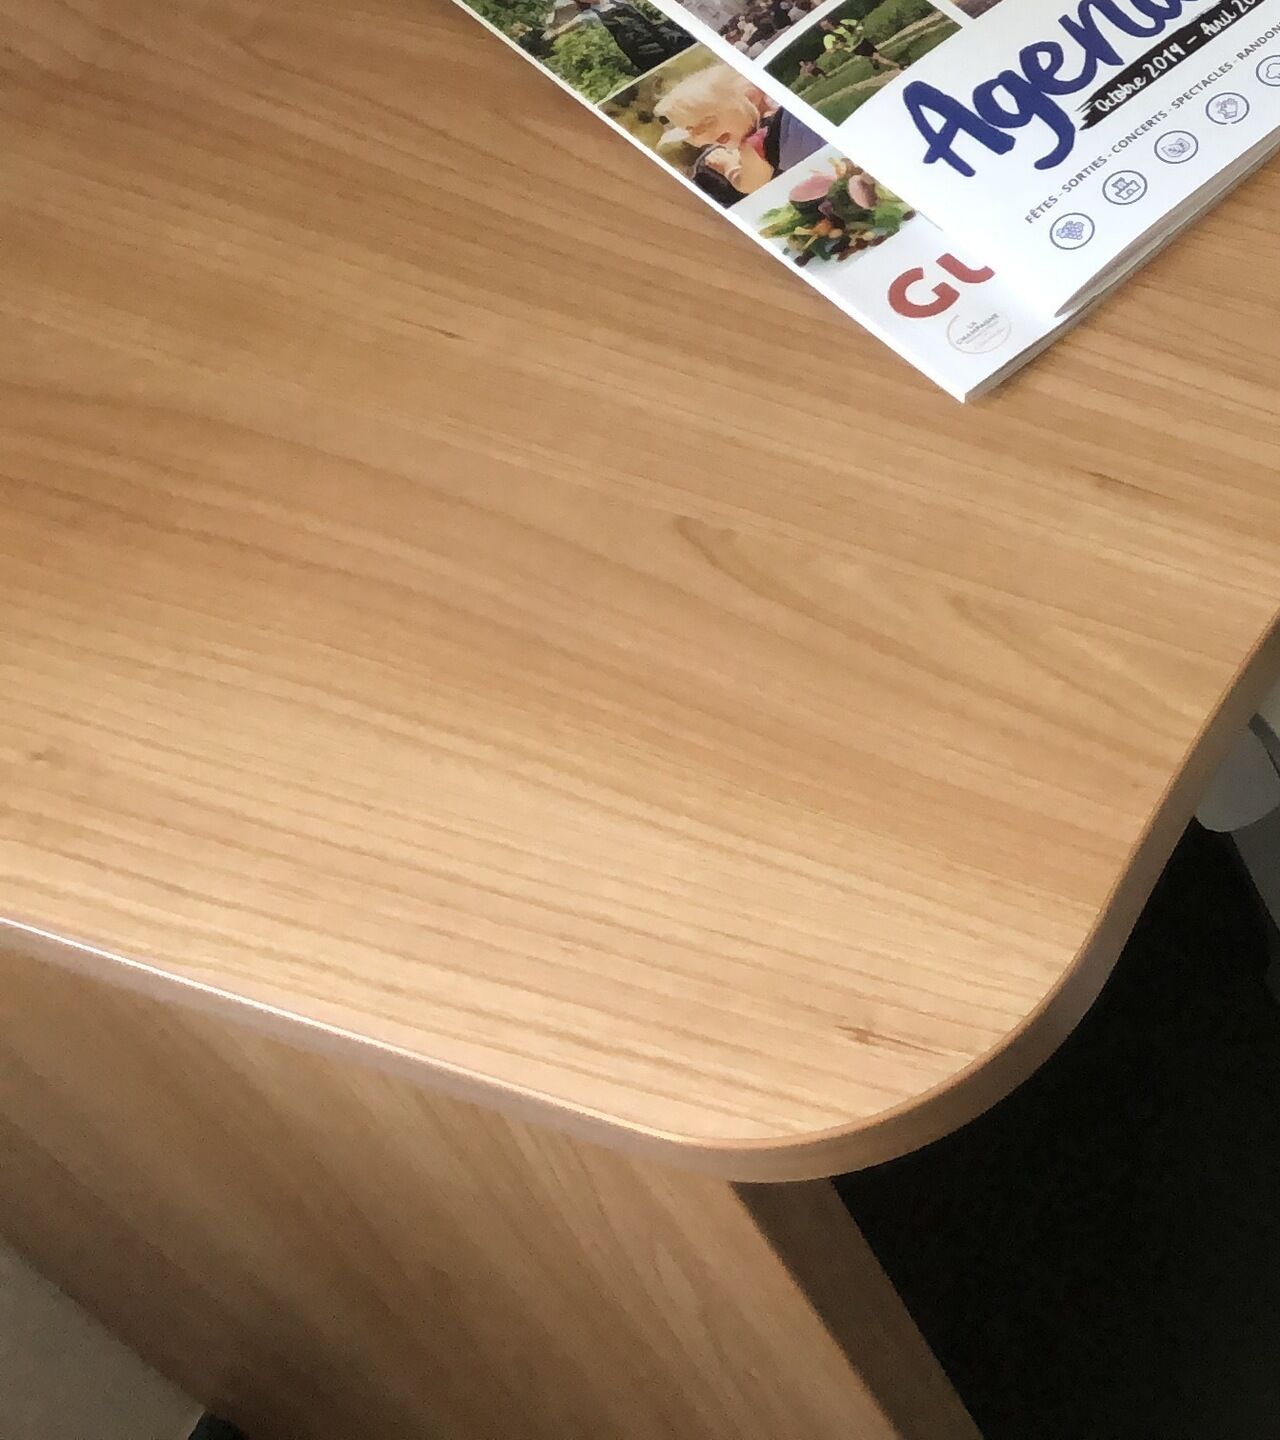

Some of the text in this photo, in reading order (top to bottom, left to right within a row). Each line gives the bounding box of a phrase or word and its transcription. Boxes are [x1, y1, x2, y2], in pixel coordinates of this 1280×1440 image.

[1095, 76, 1147, 111] Octobre
[1142, 42, 1186, 78] 2019
[1200, 9, 1238, 37] Avril
[1024, 195, 1058, 224] FÊTES
[1061, 155, 1108, 193] SORTIES
[1111, 110, 1168, 153] CONCERTS
[1171, 61, 1233, 110] SPECTACLES
